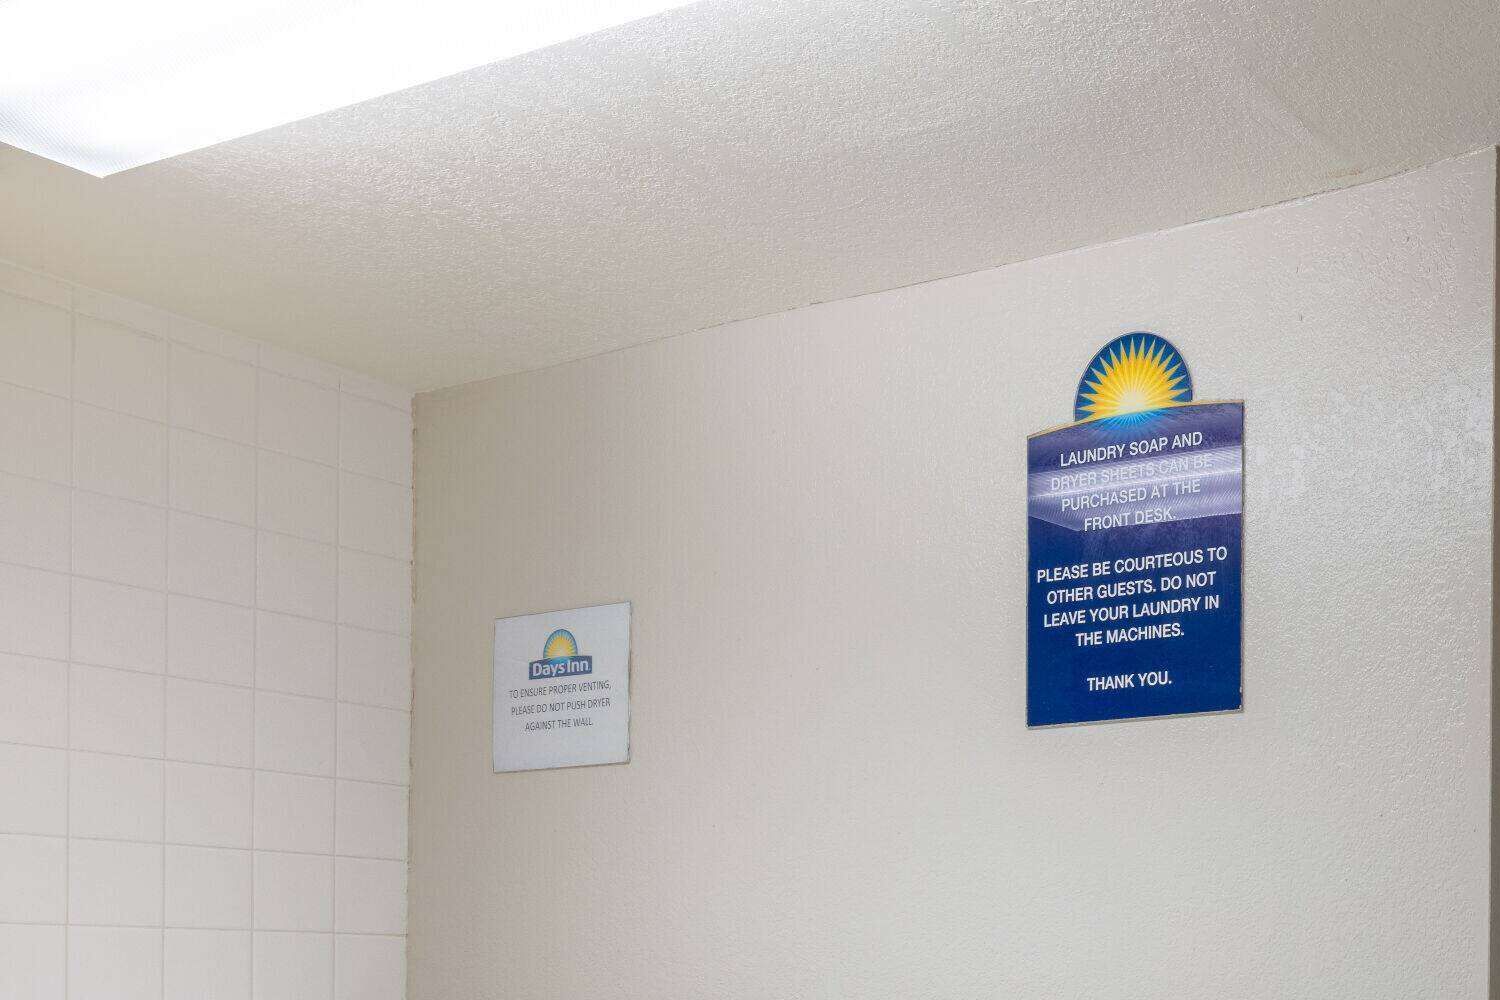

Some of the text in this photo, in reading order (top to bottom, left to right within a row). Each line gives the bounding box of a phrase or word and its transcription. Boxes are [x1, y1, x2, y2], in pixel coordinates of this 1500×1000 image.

[1060, 432, 1203, 467] LAUNDRY SOAP AND
[1051, 454, 1212, 491] DRYER SHEETS CAN BE
[1062, 479, 1200, 512] PURCHASED AT THE
[1084, 505, 1176, 532] FRONT DESK.
[1037, 546, 1227, 583] PLEASE BE COURTEOUS TO
[1047, 571, 1216, 605] OTHER GUESTS. DO NOT
[1044, 594, 1219, 628] LEAVE YOUR LAUNDRY IN
[1076, 622, 1184, 647] THE MACHINES.
[510, 680, 612, 699] TO ENSURE PROPER VENTING,
[1087, 670, 1172, 692] THANK YOU.
[511, 698, 611, 716] PLEASE DO NOT PUSH DRYER
[525, 720, 555, 732] AGAINST
[558, 719, 571, 728] THE
